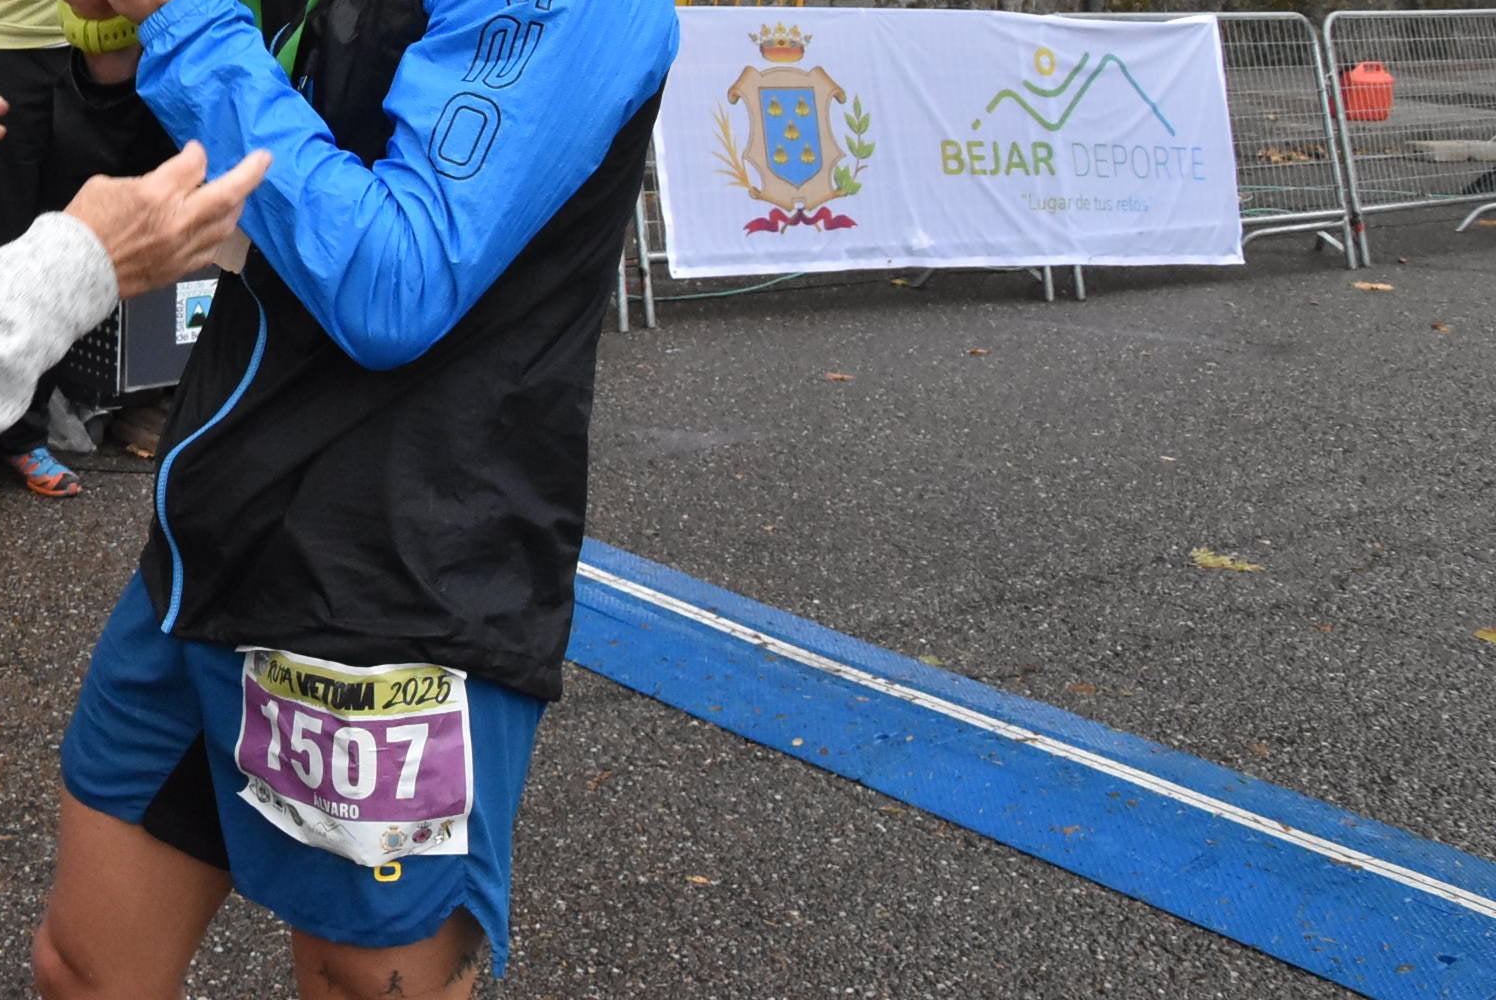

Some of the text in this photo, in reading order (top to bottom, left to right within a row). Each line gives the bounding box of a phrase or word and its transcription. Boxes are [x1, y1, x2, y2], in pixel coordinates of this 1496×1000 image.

[939, 118, 1206, 181] BÉJAR DEPORTE
[1075, 195, 1090, 211] de
[1093, 196, 1113, 212] tus
[268, 660, 452, 711] RUTA VETONA 2025
[261, 698, 429, 800] 1507
